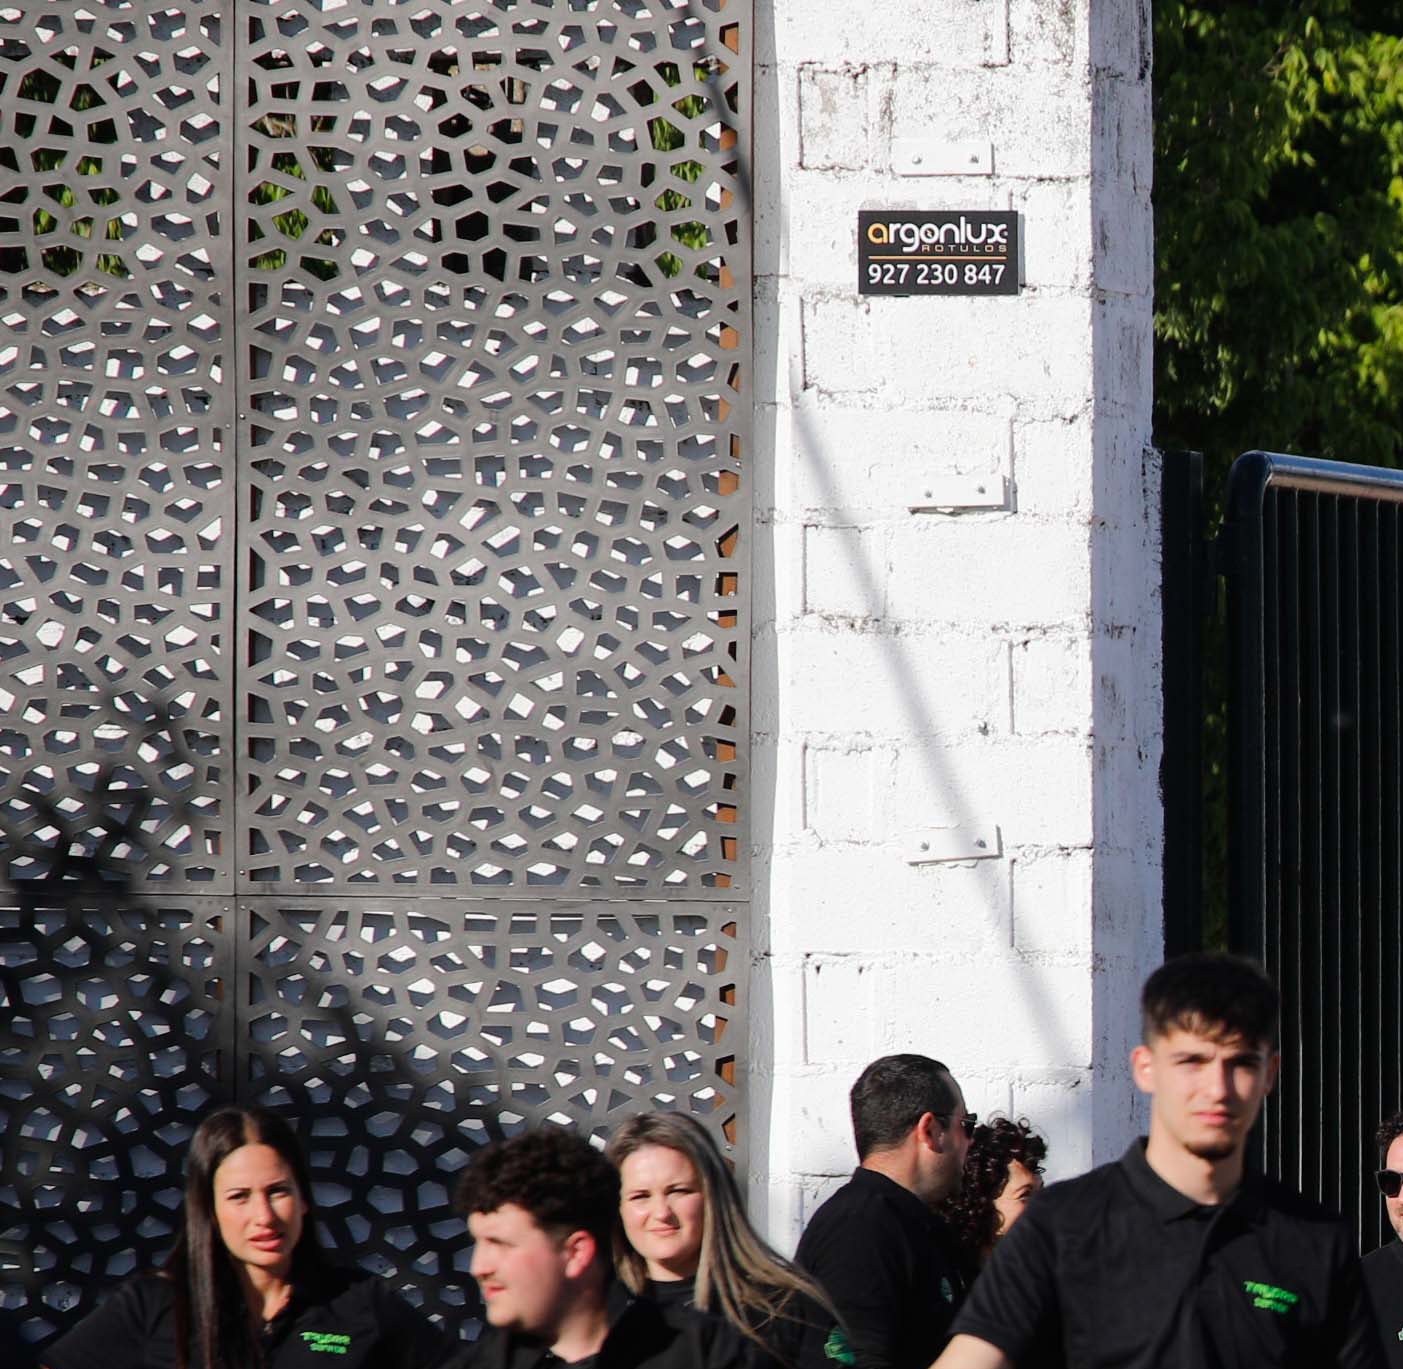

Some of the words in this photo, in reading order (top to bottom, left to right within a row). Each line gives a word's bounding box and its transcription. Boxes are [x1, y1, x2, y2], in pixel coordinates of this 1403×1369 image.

[867, 216, 1008, 252] argonlux
[921, 244, 1007, 252] ROTULOS
[868, 264, 910, 284] 927
[916, 264, 957, 284] 230
[964, 264, 1005, 284] 847
